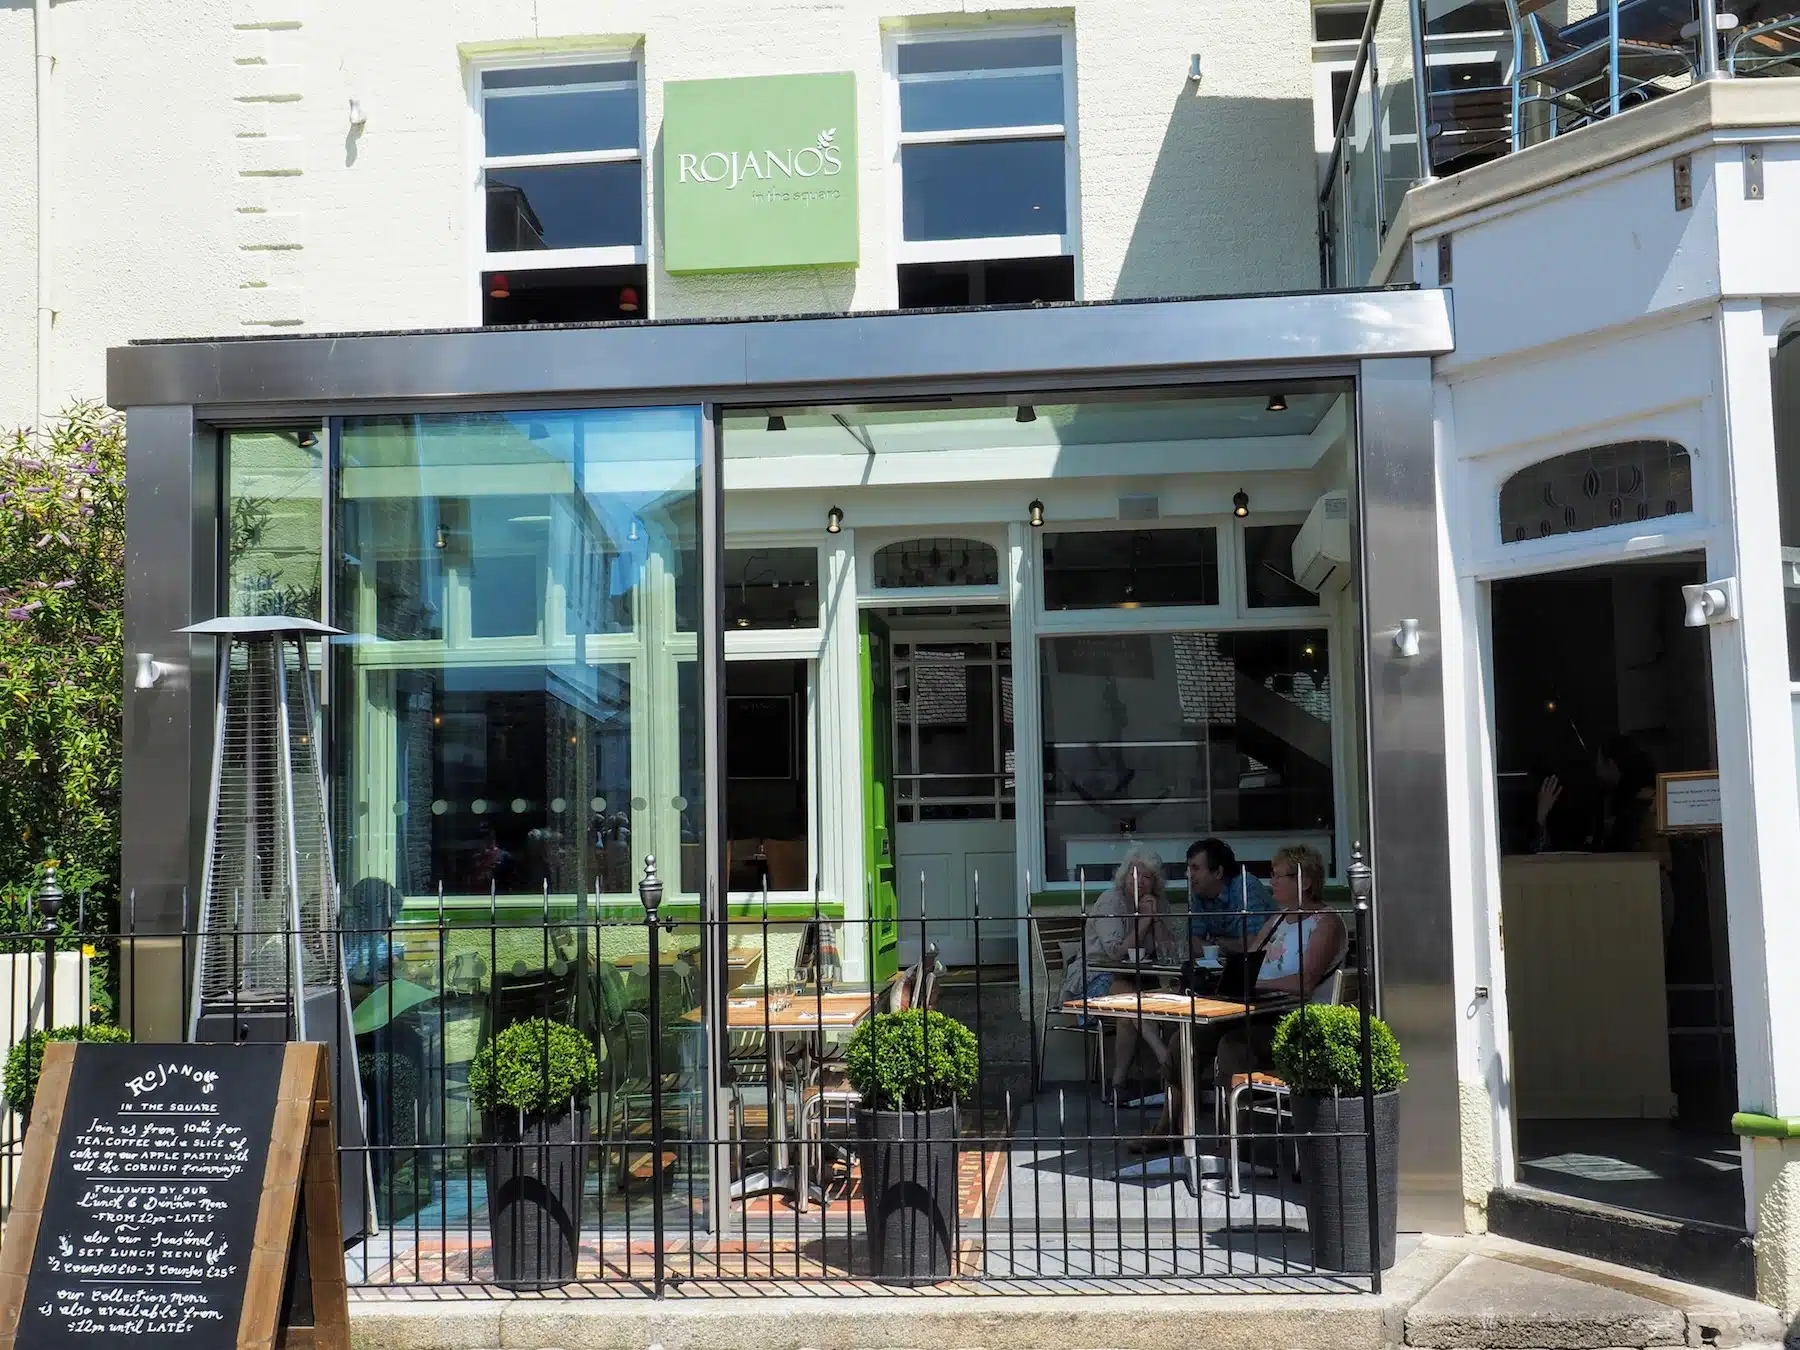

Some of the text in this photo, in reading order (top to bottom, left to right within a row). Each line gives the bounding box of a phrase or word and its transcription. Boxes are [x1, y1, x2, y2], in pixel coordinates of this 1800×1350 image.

[751, 186, 841, 208] in the square
[120, 1103, 218, 1112] IN THE SQUARE
[86, 1118, 115, 1135] Join
[120, 1124, 137, 1136] us
[140, 1123, 176, 1138] from
[213, 1124, 242, 1140] for
[154, 1136, 179, 1147] and
[193, 1139, 225, 1148] SLICE
[229, 1137, 248, 1152] of
[69, 1147, 249, 1162] cake or our APPLE PASTY with
[73, 1159, 95, 1172] all
[97, 1159, 120, 1175] the
[124, 1163, 177, 1173] CORNISH
[94, 1184, 209, 1195] FOLLOWED BY OUR
[76, 1191, 125, 1210] Lunch
[143, 1195, 197, 1211] Dinner
[83, 1230, 111, 1244] also
[117, 1235, 142, 1244] our
[78, 1248, 203, 1259] SET LUNCH MENU
[205, 1266, 229, 1278] £25
[57, 1289, 85, 1301] our
[38, 1301, 224, 1323] is also available from
[108, 1319, 144, 1335] until
[146, 1322, 186, 1333] LATE
